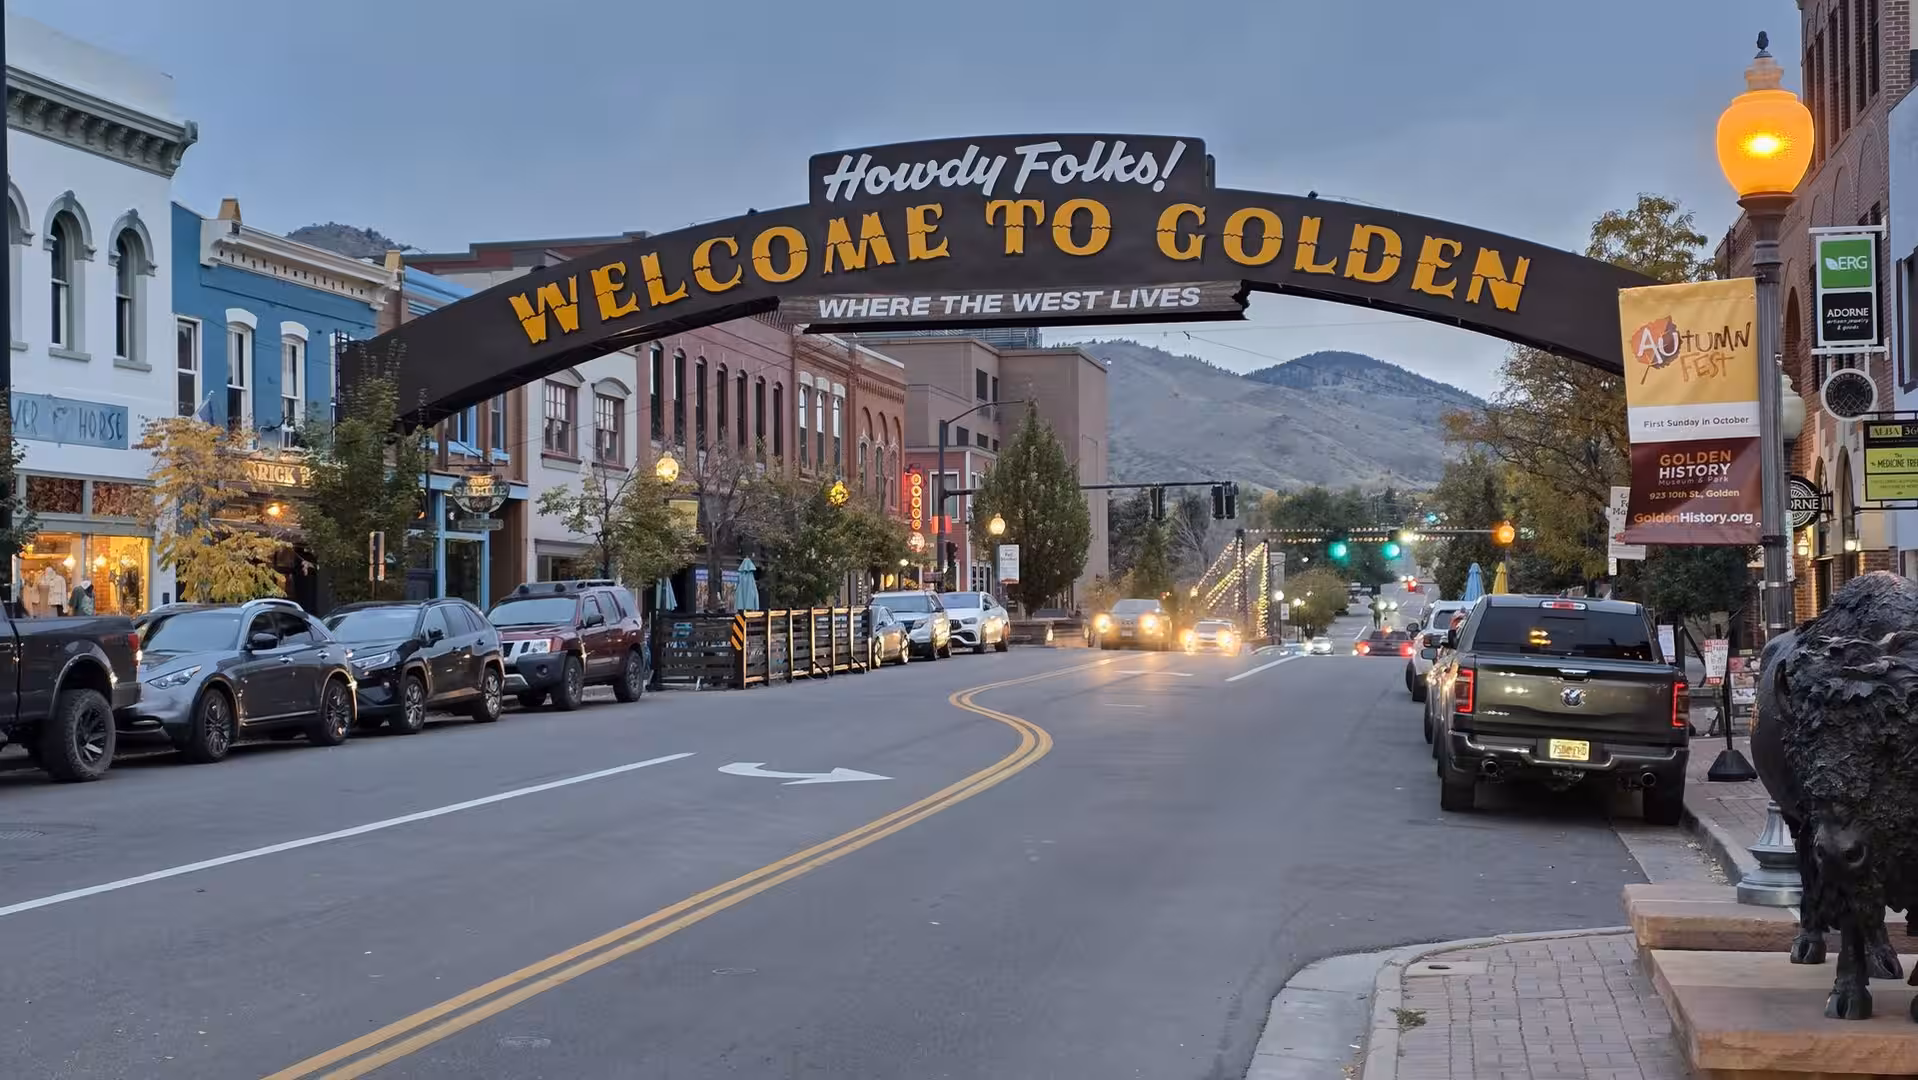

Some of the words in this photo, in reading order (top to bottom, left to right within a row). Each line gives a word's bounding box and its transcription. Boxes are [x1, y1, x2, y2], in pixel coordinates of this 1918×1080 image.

[823, 144, 1007, 202] Howdy
[1013, 140, 1186, 194] Folks!
[1838, 256, 1868, 270] ERG
[508, 203, 950, 344] WELCOME
[985, 199, 1111, 256] TO
[1156, 203, 1531, 312] GOLDEN
[819, 296, 932, 318] WHERE
[940, 294, 1003, 314] THE
[1013, 289, 1107, 312] WEST
[1110, 287, 1201, 309] LIVES
[1827, 308, 1869, 317] ADORNE
[79, 407, 122, 440] HORSE
[1643, 420, 1664, 428] First
[1667, 419, 1699, 427] Sunday
[1713, 416, 1749, 425] October
[1660, 450, 1731, 466] GOLDEN
[1877, 459, 1905, 468] MEDICINE
[1660, 463, 1731, 479] HISTORY
[1658, 478, 1694, 486] Museum
[1708, 475, 1729, 483] Park
[1668, 491, 1687, 499] 10th
[1706, 489, 1740, 498] Golden
[1634, 512, 1753, 525] GoldenHistory.org
